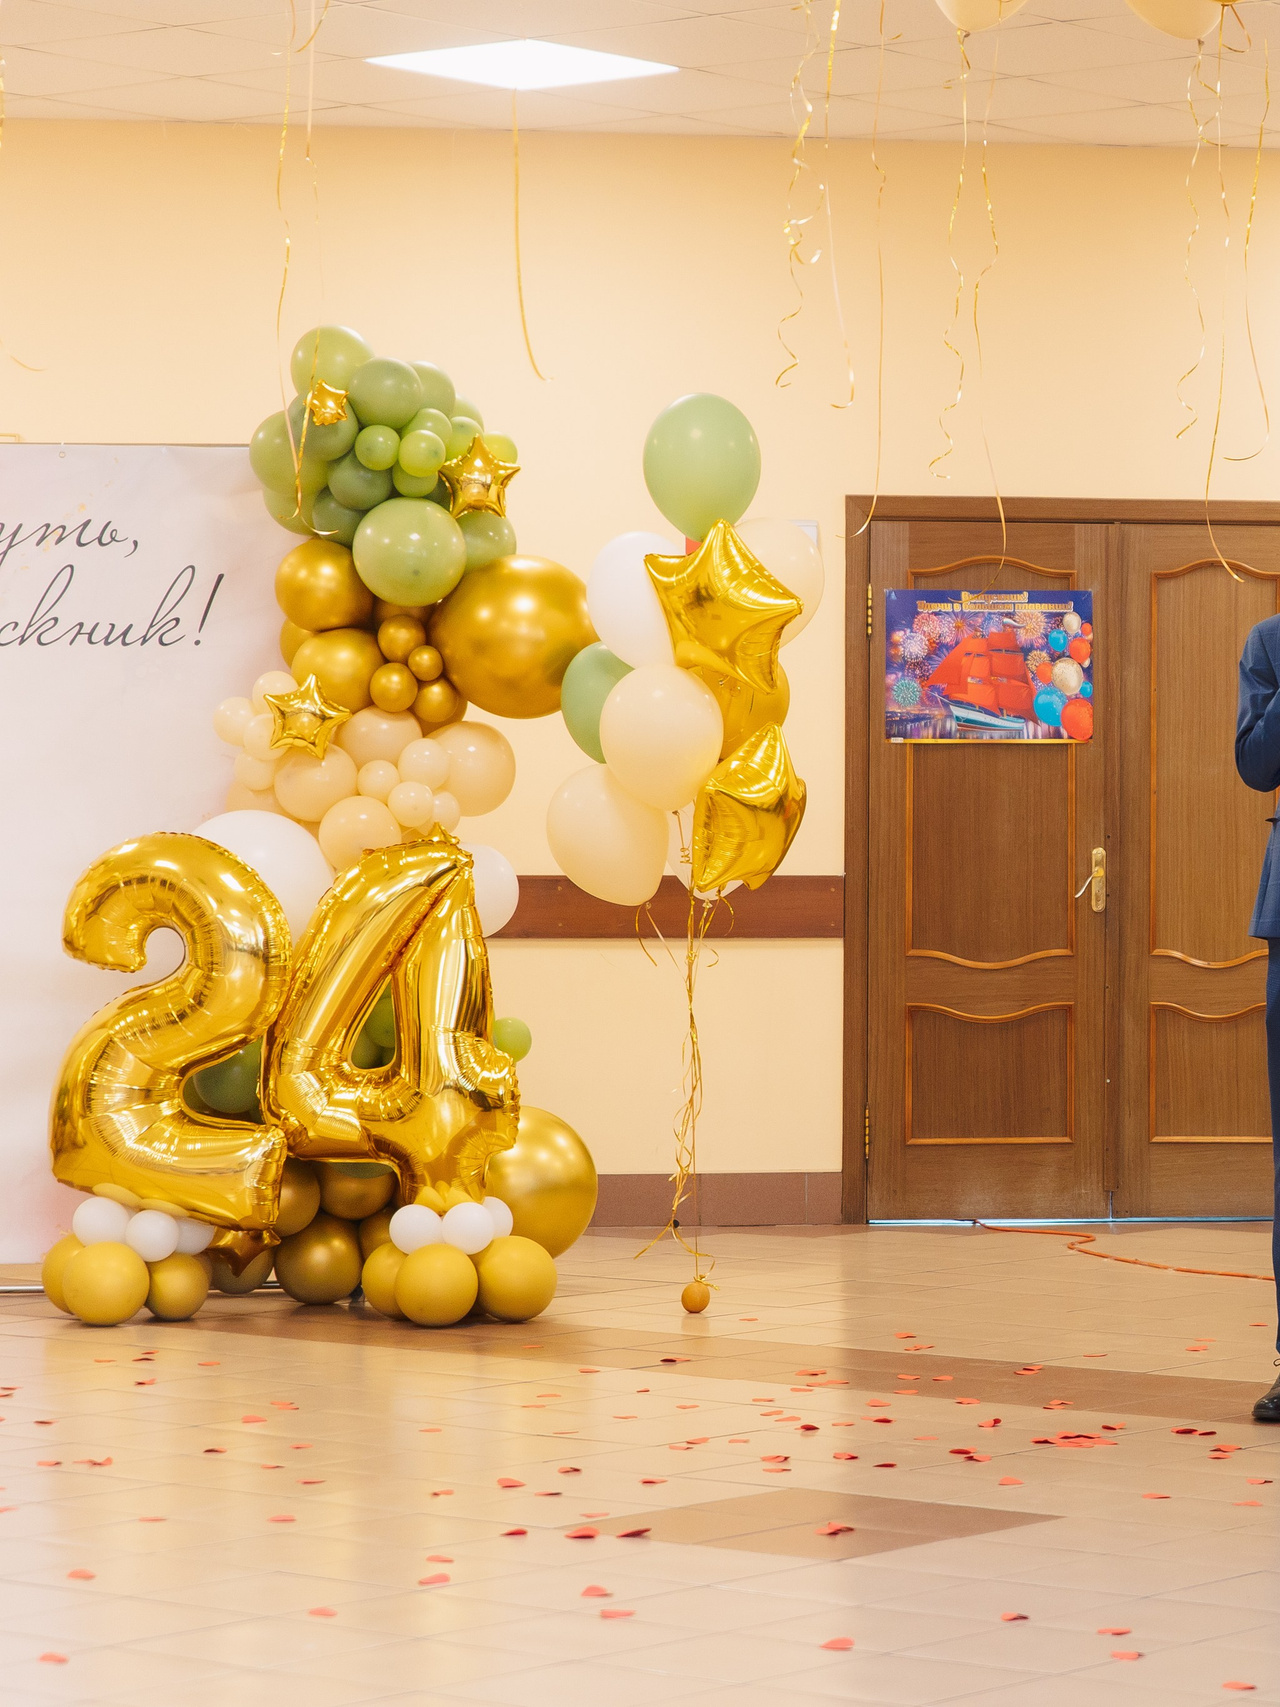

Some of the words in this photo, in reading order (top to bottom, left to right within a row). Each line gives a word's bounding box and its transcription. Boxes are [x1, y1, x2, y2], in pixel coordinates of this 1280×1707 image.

[961, 591, 1028, 604] Выпускник!
[917, 601, 952, 613] Удачи
[953, 602, 962, 612] в
[962, 601, 1014, 612] большом
[50, 824, 521, 1232] 24
